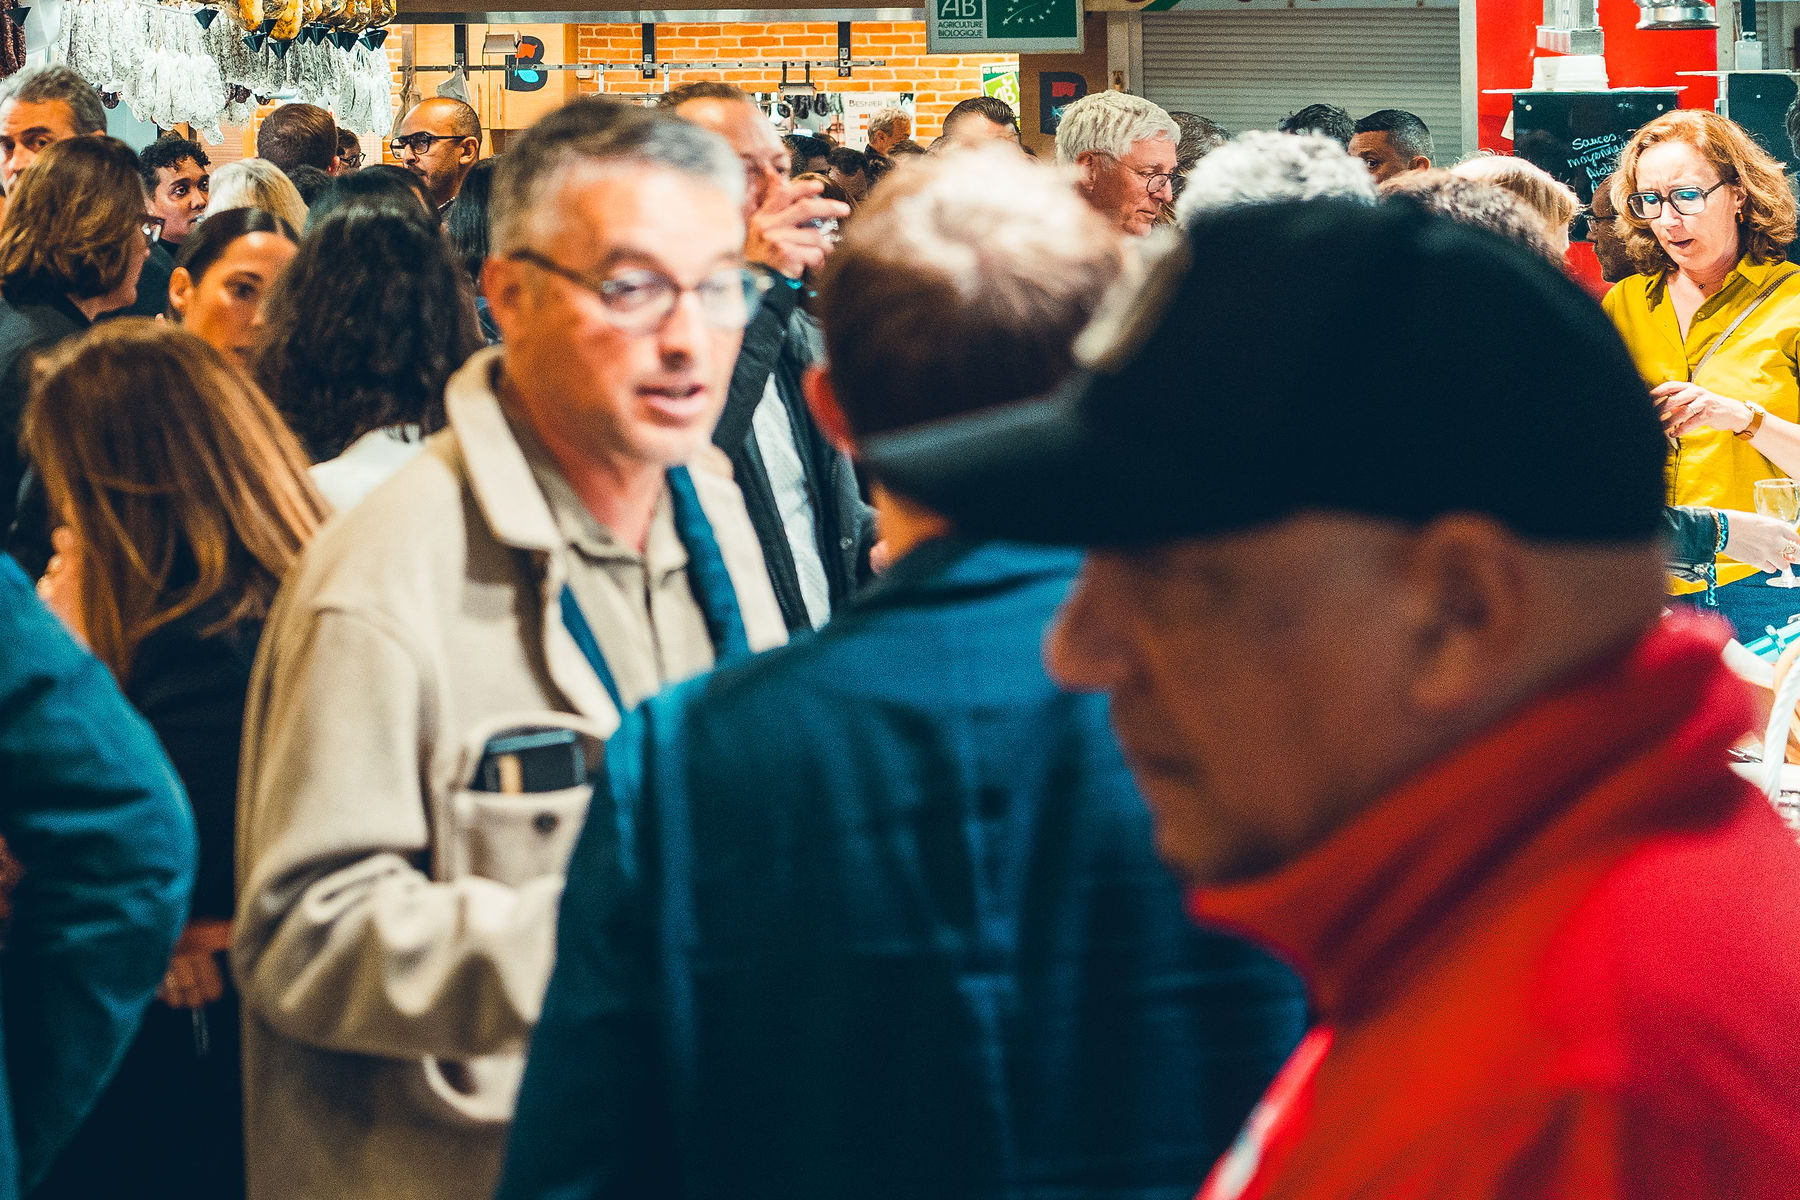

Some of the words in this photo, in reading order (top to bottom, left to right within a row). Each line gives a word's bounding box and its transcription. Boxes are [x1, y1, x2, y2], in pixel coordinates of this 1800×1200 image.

[938, 21, 983, 29] AGRICULTURE
[938, 29, 983, 37] BIOLOGIQUE
[848, 99, 883, 108] BESNIER
[1566, 139, 1627, 168] mayonnai
